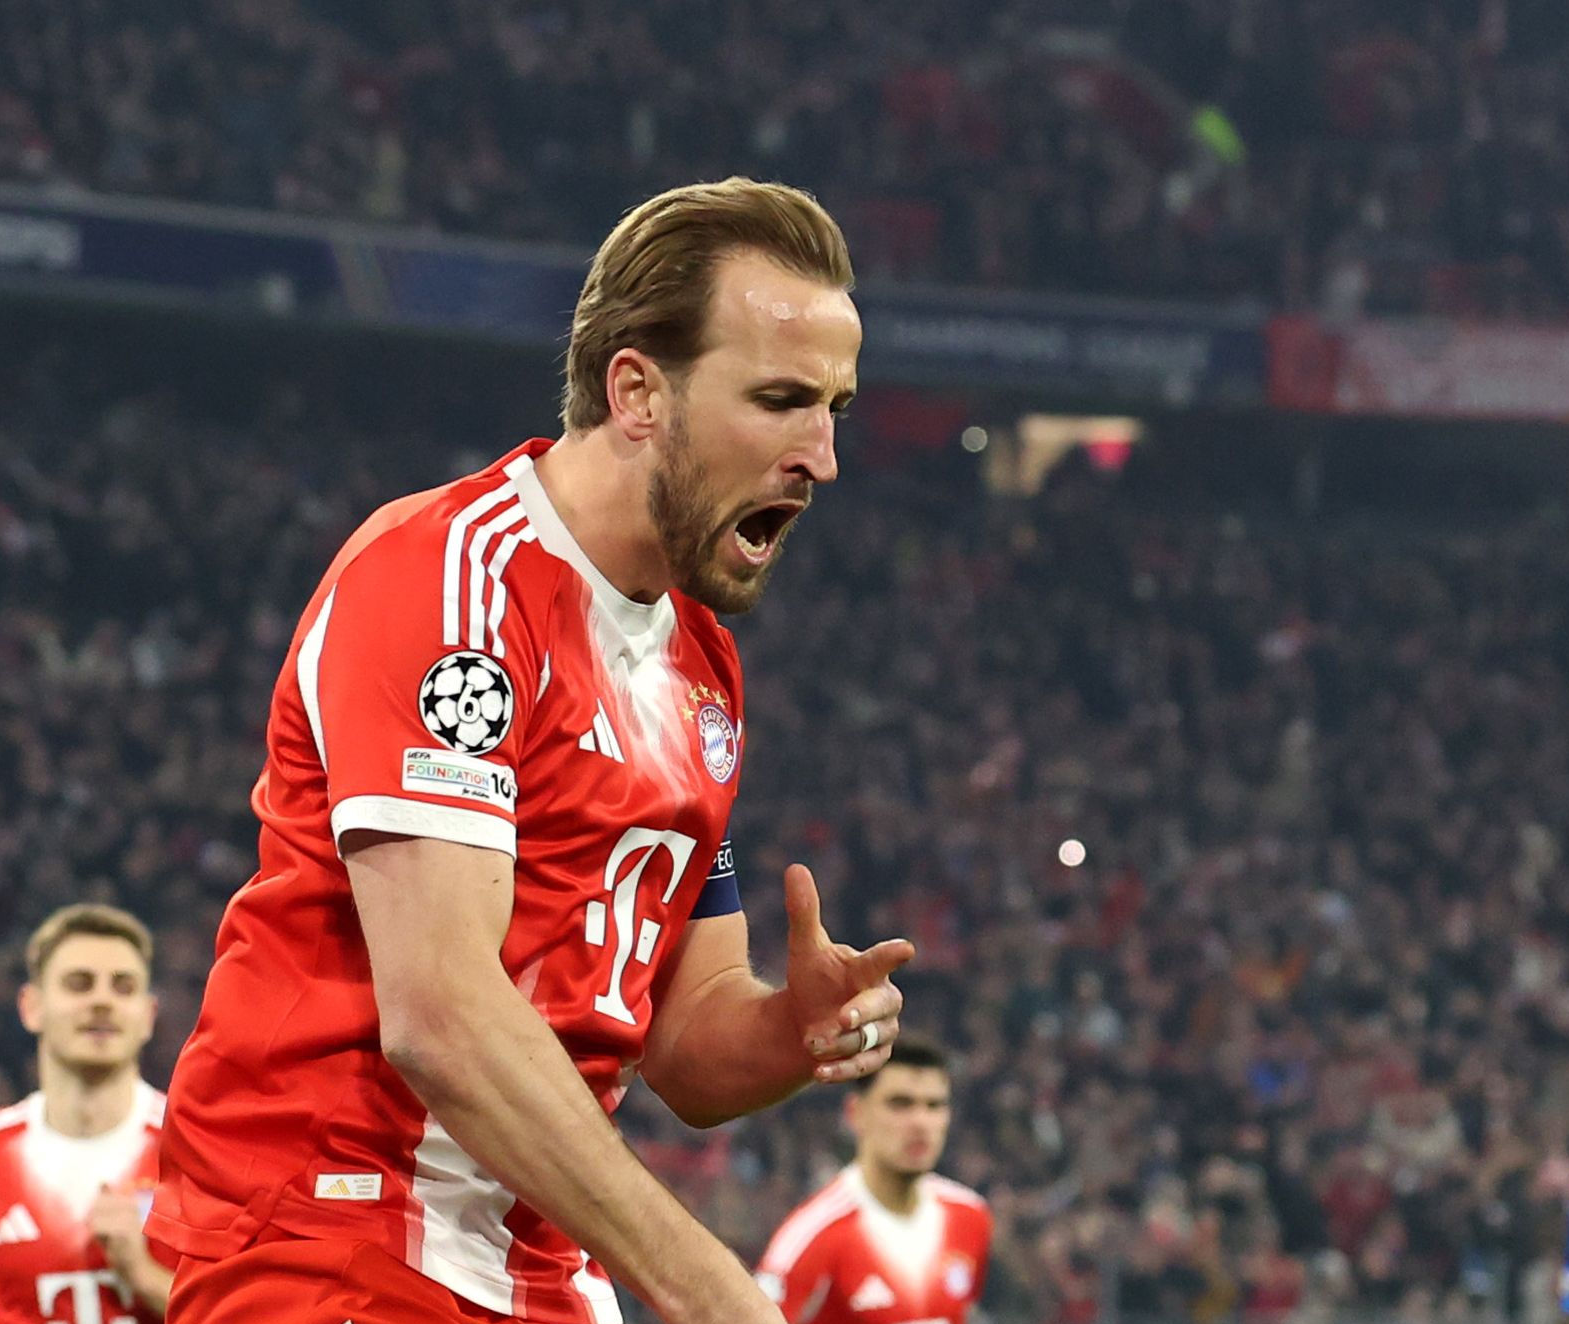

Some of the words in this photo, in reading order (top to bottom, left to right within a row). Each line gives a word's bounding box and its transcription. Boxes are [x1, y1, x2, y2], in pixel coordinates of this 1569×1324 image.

[457, 684, 481, 723] 6
[407, 751, 431, 761] UEFA
[407, 764, 489, 786] FOUNDATION
